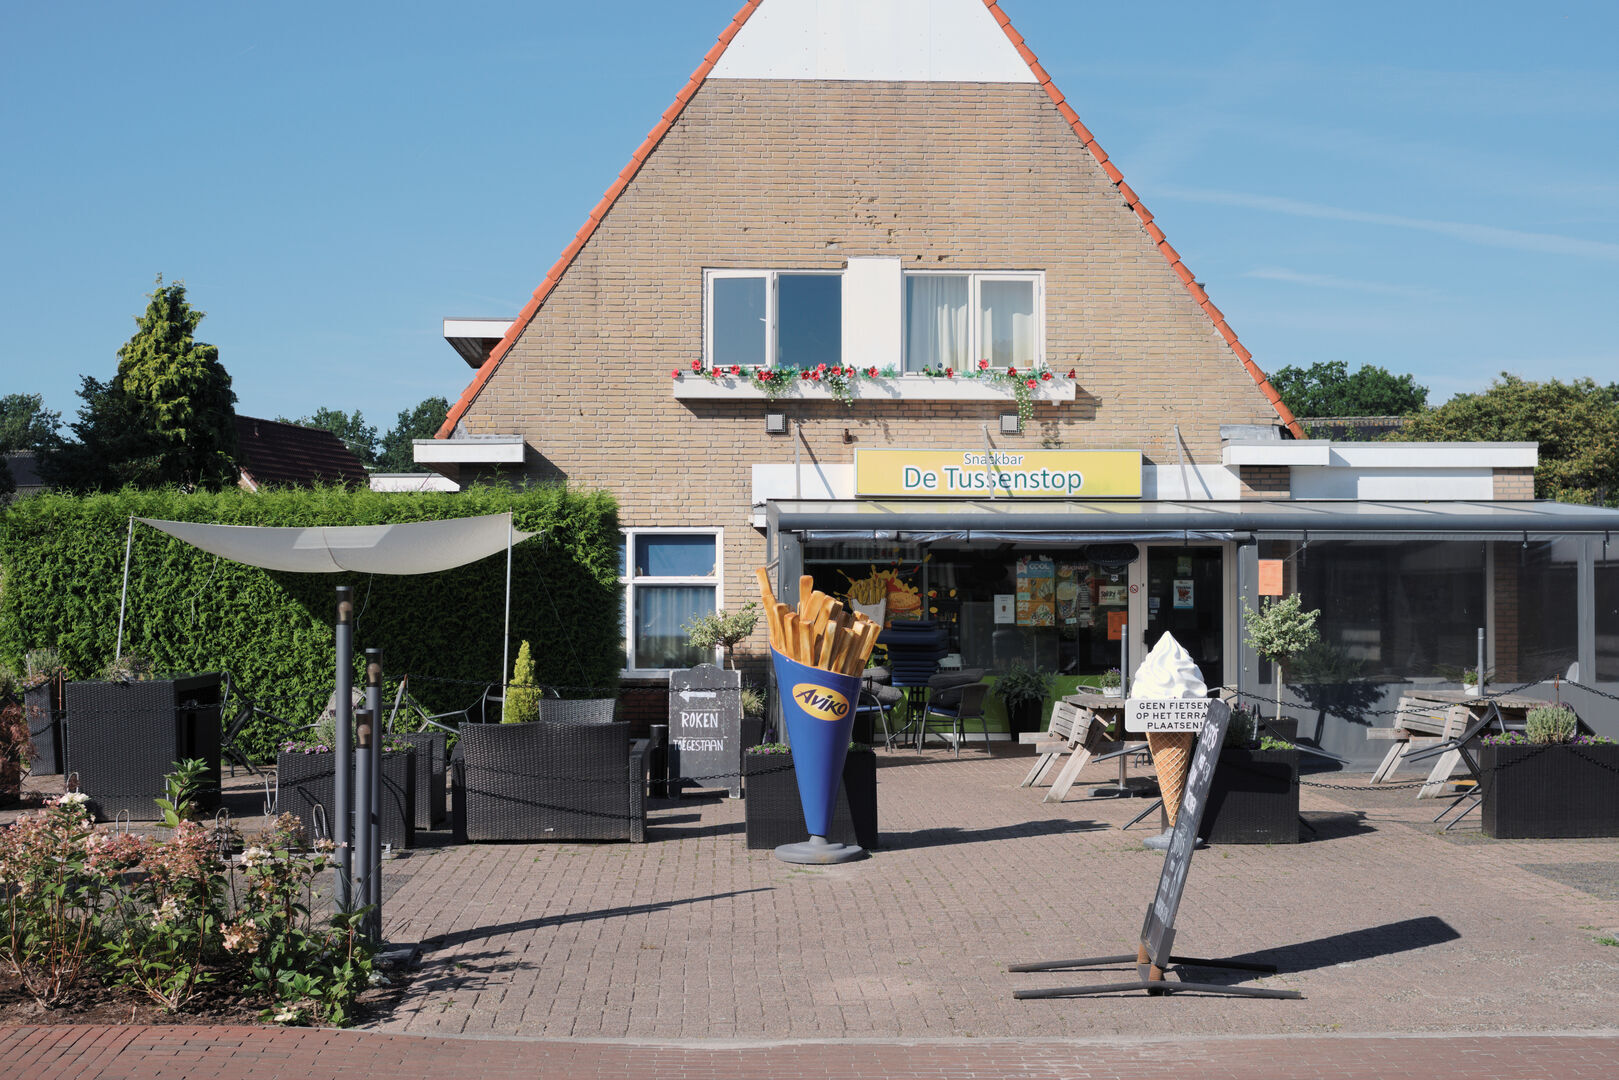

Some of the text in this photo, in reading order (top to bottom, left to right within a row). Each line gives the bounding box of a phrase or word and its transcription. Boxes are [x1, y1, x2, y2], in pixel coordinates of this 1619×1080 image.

[905, 467, 1082, 493] De Tussenstop
[795, 688, 848, 717] Aviko
[1139, 702, 1210, 710] GEEN FIETSEN
[680, 711, 719, 729] ROKEN
[1136, 712, 1207, 720] OP HET TERRA
[1147, 722, 1203, 730] PLAATSEN!
[673, 738, 724, 752] TOEGESTAAN
